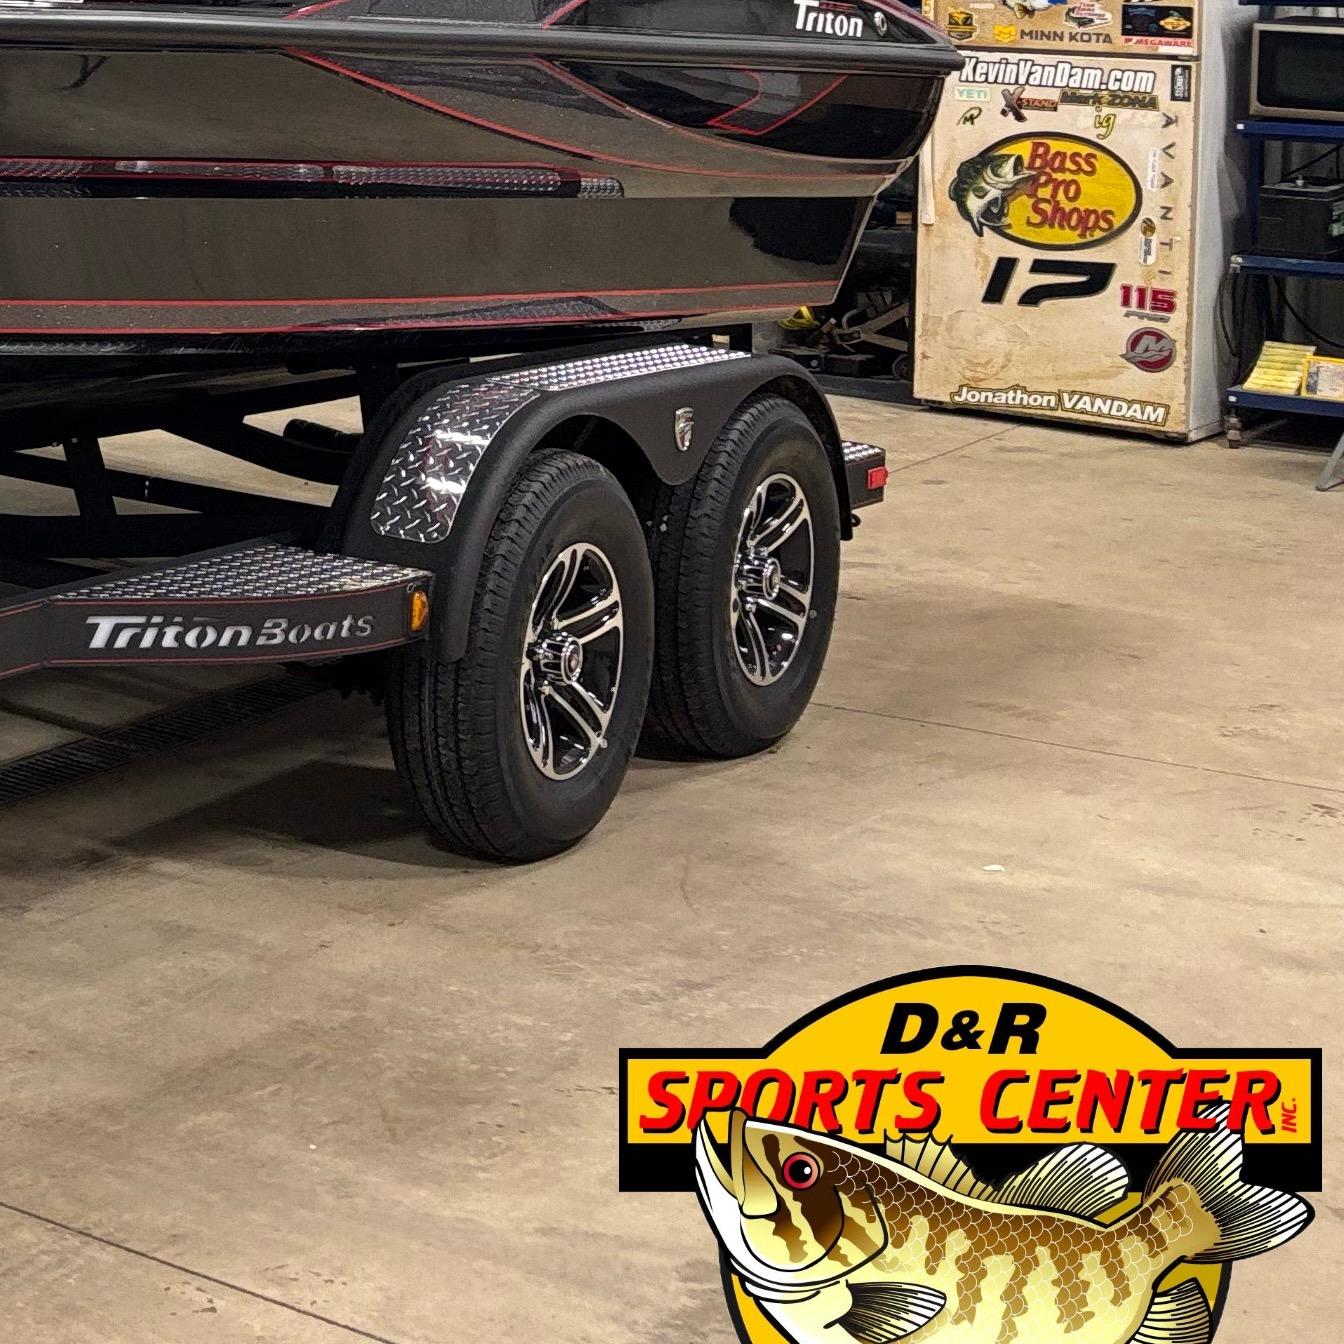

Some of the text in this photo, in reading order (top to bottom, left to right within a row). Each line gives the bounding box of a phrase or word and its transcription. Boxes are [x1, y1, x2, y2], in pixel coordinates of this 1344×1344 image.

[1020, 29, 1112, 44] MINN KOTA
[959, 58, 1156, 94] KevinVanDam.com
[1025, 141, 1099, 177] Bass
[1028, 171, 1082, 202] Pro
[1026, 197, 1116, 239] Shops
[1120, 284, 1178, 314] 115
[954, 386, 1166, 424] Jonathon VANDAM
[85, 614, 375, 649] Triton Boats
